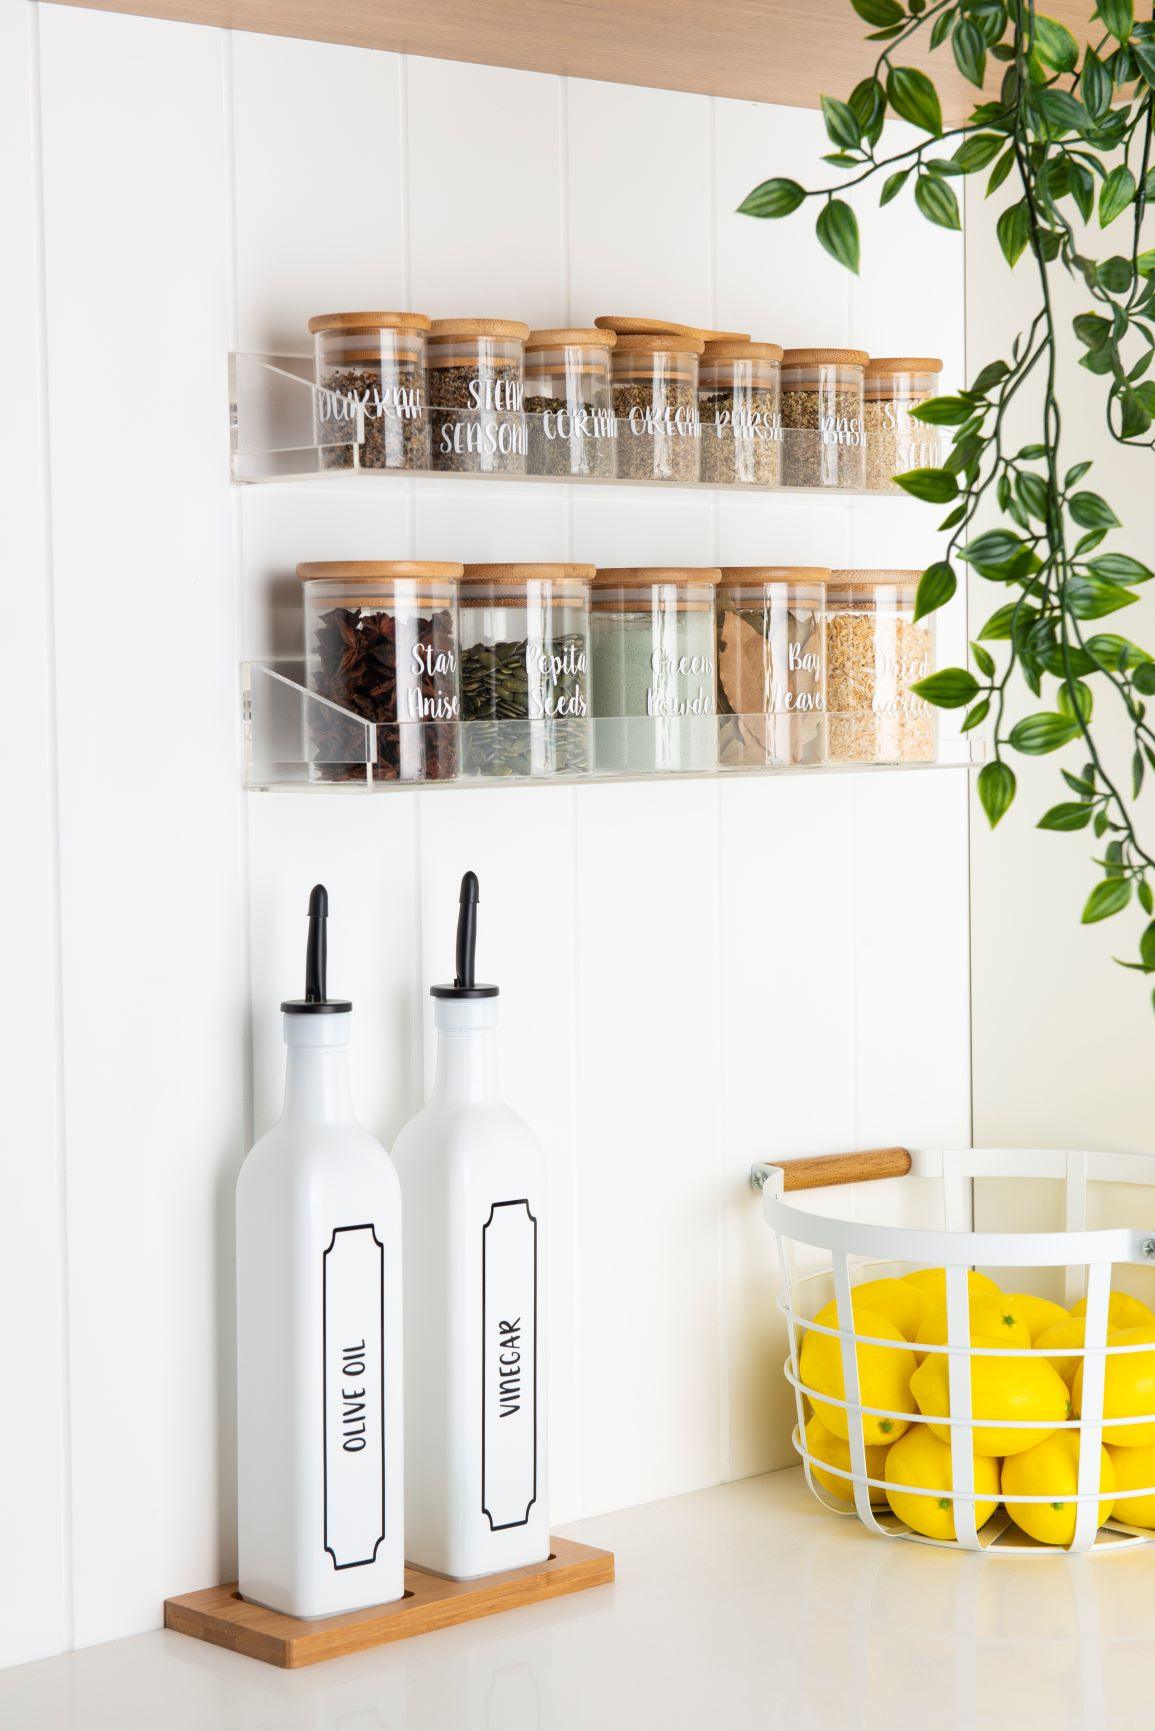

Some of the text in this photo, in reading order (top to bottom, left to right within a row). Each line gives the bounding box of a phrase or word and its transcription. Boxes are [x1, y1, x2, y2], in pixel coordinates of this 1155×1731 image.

[467, 379, 525, 412] STEAK
[411, 643, 457, 676] Star
[788, 642, 821, 682] Bay
[407, 686, 460, 720] Anise
[531, 684, 588, 717] Seeds
[499, 1316, 522, 1418] VINEGAR
[342, 1338, 366, 1453] OLIVE OIL
